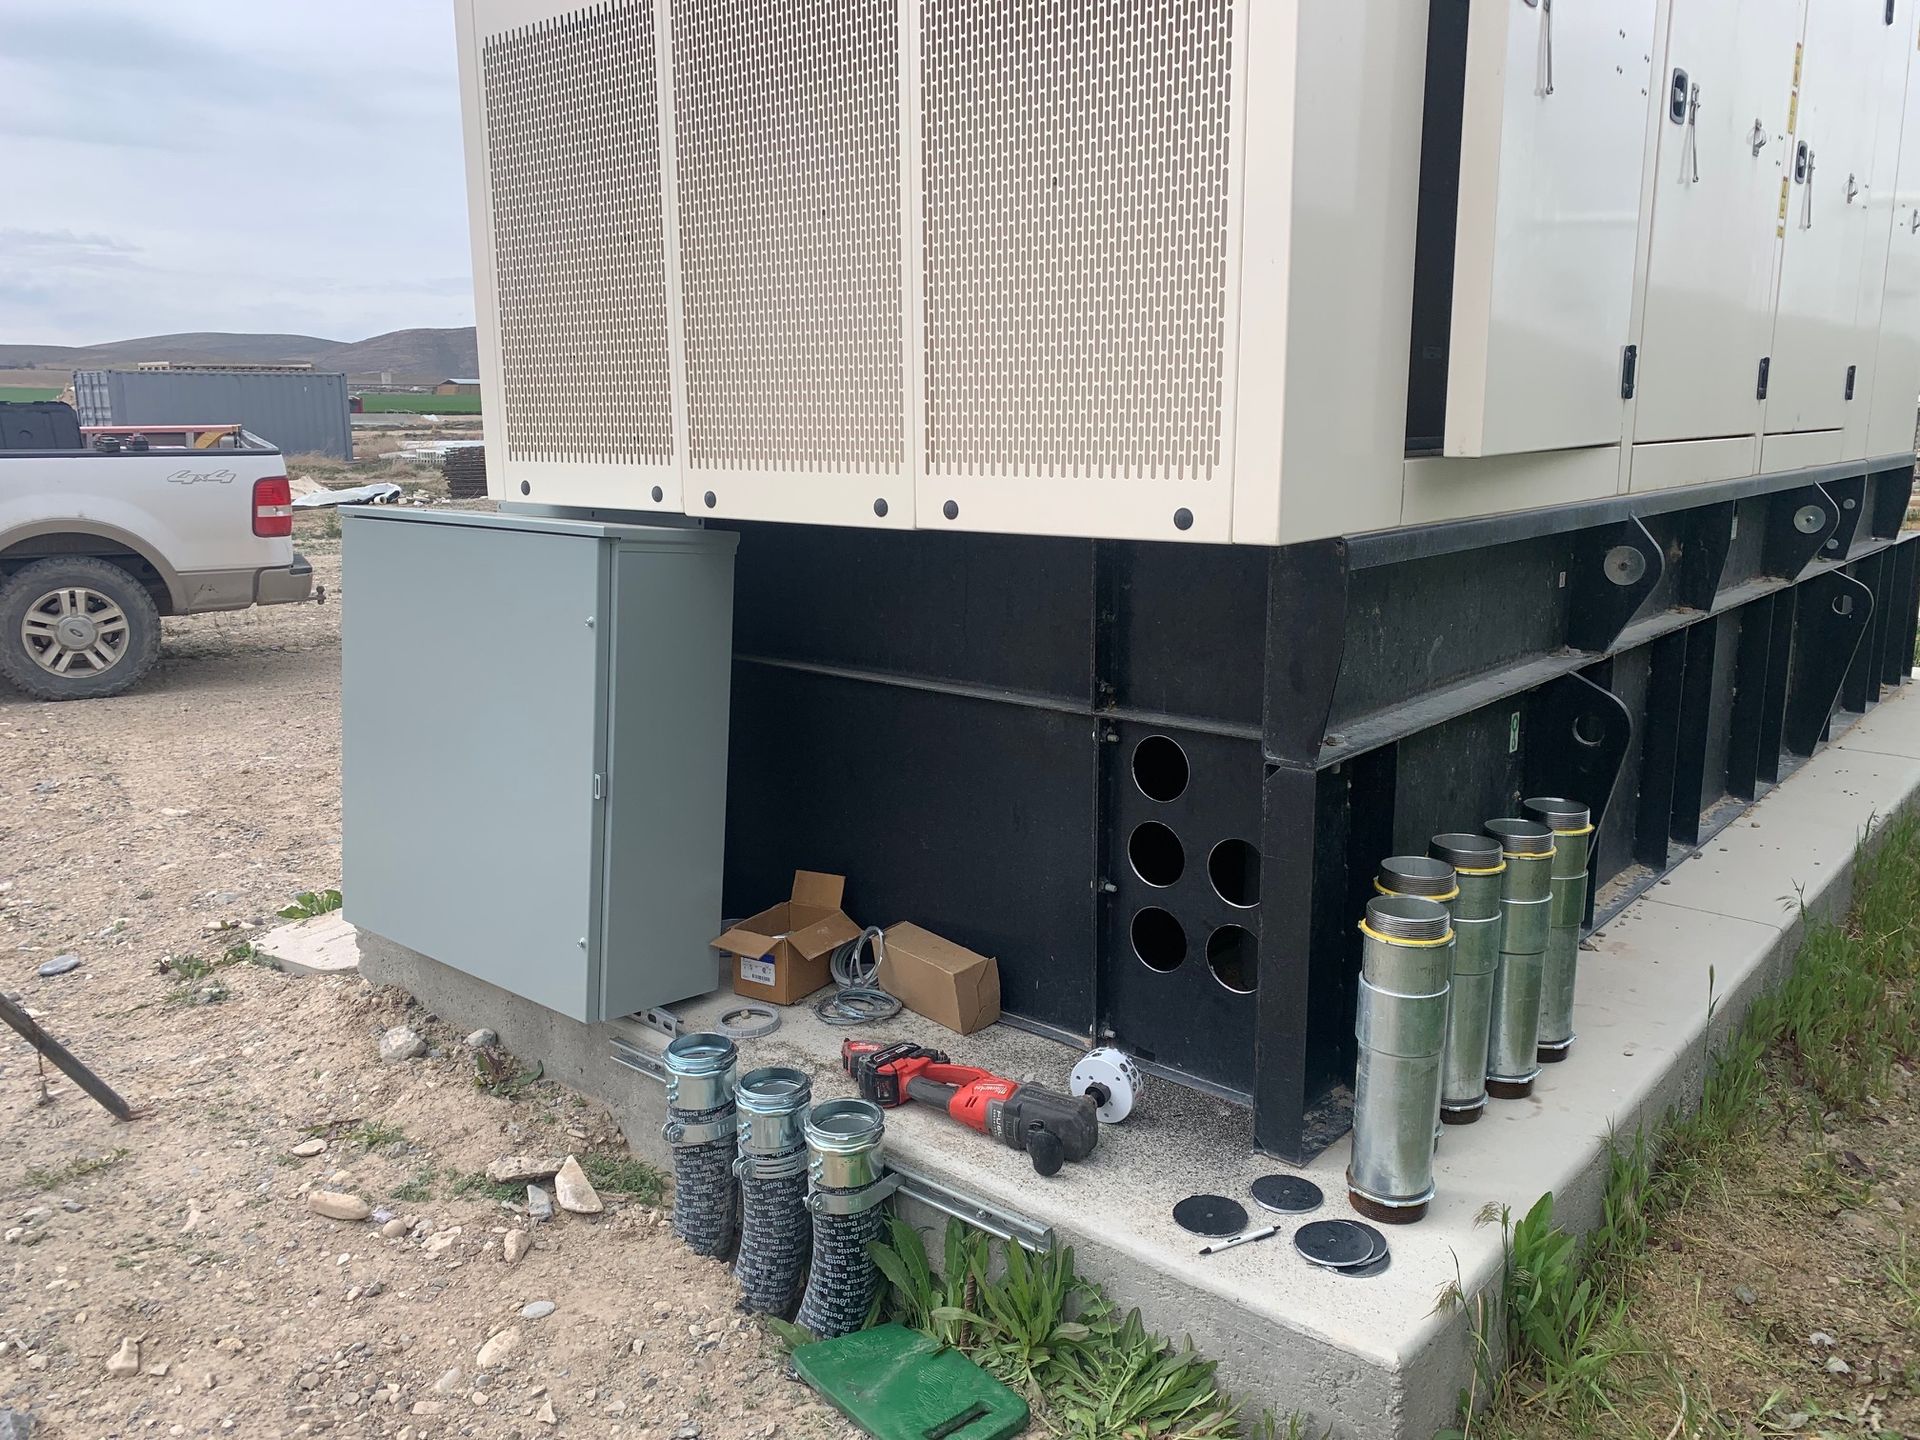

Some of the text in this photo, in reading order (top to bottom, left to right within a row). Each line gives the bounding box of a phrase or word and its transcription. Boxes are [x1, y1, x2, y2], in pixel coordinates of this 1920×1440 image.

[167, 469, 237, 485] 4x4
[700, 1149, 722, 1157] Dottie
[762, 1182, 782, 1190] Dottie
[846, 1263, 868, 1271] Dottie
[843, 1289, 865, 1297] Dottie
[821, 1309, 843, 1320] Dottie
[827, 1322, 849, 1331] Dottie
